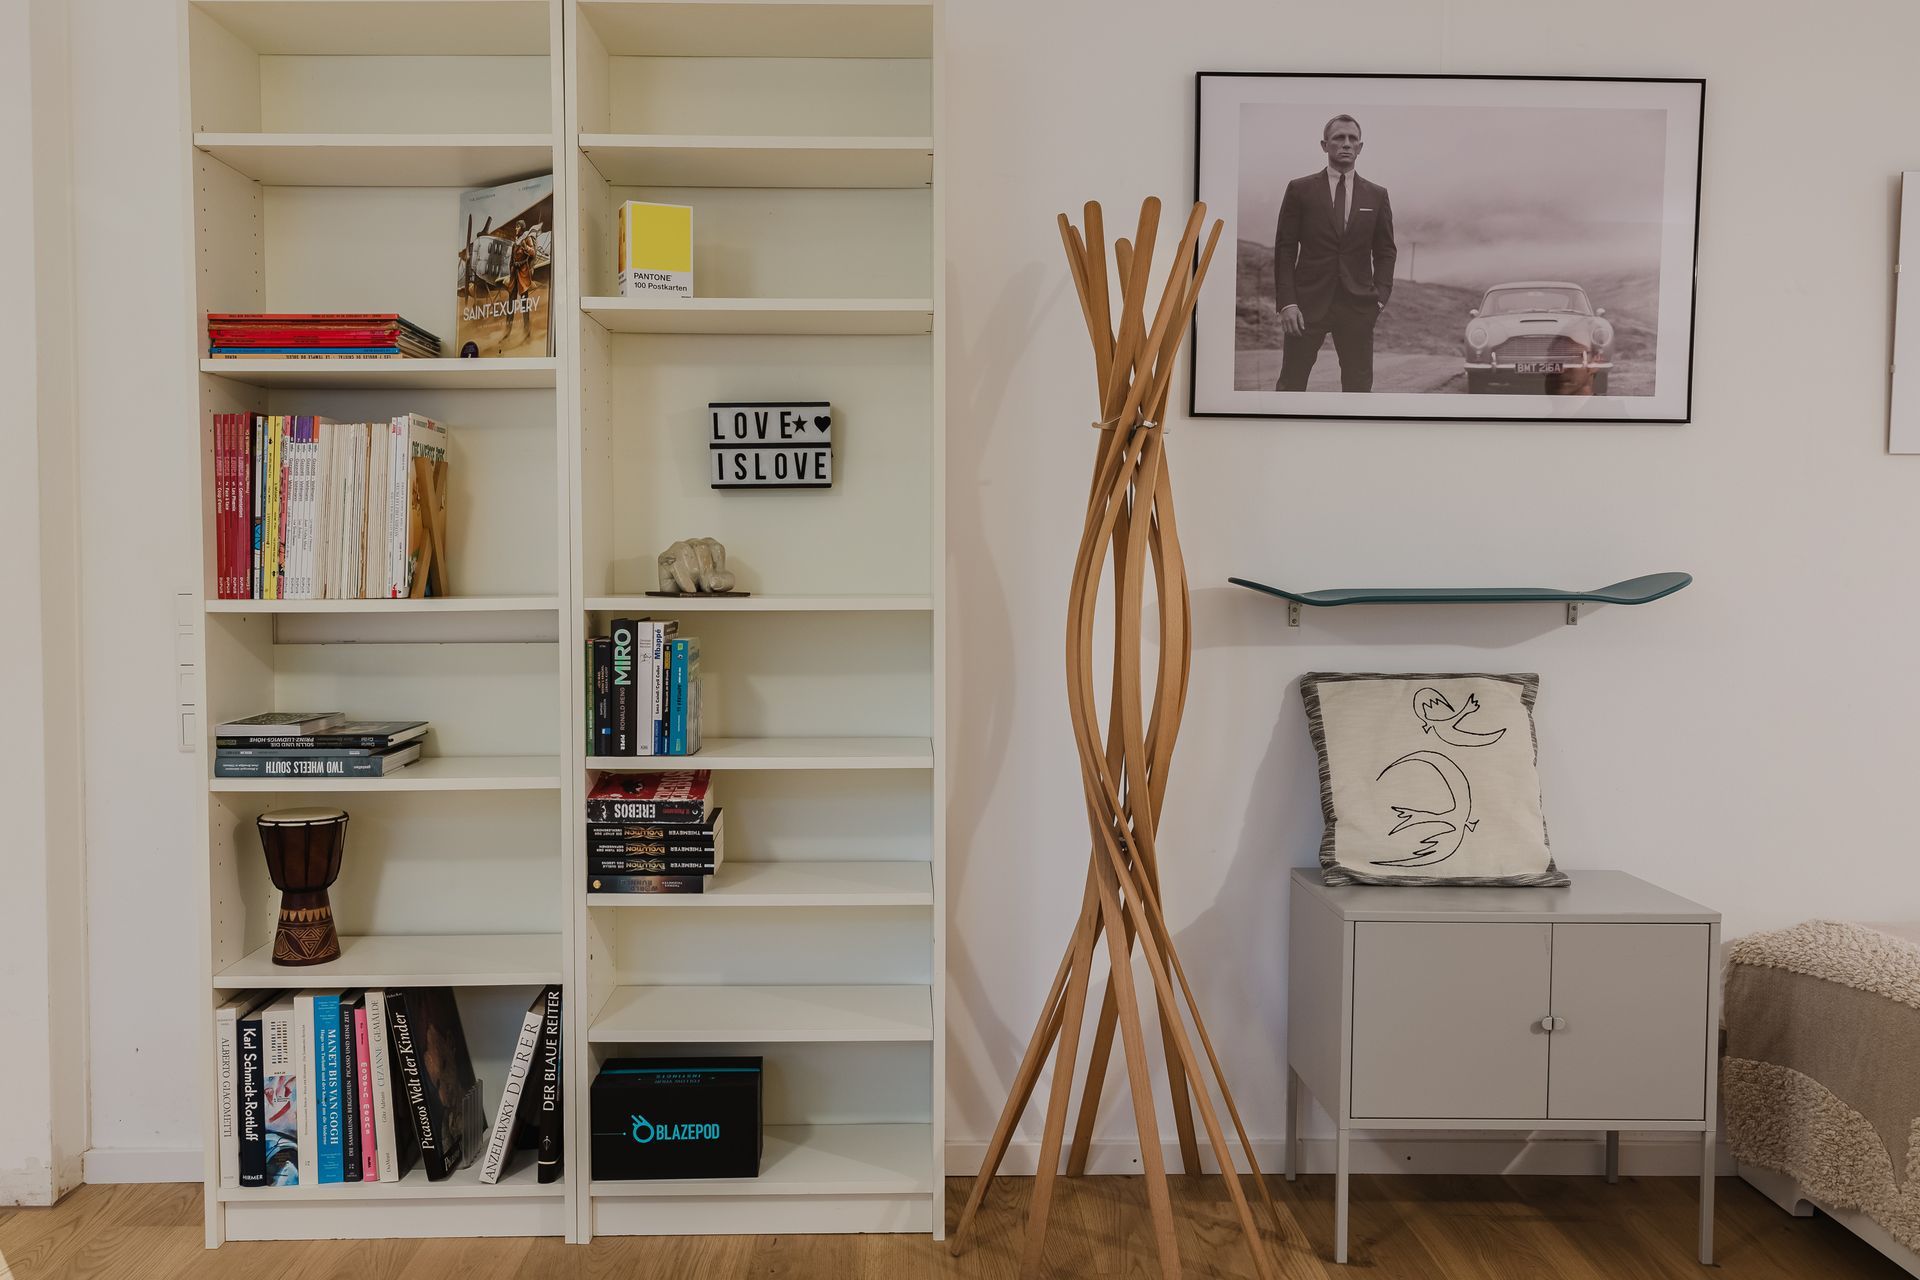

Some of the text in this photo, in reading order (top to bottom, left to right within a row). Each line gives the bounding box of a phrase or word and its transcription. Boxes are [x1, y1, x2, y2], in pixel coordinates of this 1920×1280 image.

[634, 272, 671, 281] PANTONE
[648, 283, 687, 291] Postkarten
[463, 296, 540, 321] SAINT-EXUPÉRY
[1517, 363, 1561, 372] BMT 216A
[713, 412, 792, 439] LOVE
[654, 629, 662, 659] Mbappé
[614, 629, 632, 685] MIRO
[266, 761, 291, 774] SOUTH
[293, 761, 324, 773] WHEELS
[326, 761, 343, 773] TWO
[614, 803, 656, 818] EREBOS
[626, 862, 666, 870] EVOLUTION
[370, 1000, 382, 1042] GEMÄLDE
[327, 1029, 337, 1067] MANET
[542, 991, 560, 1112] DER BLAUE REITER
[221, 1038, 232, 1137] ALBERTO GIACOMETTI
[243, 1028, 257, 1141] Karl Schmidt-Rottluff
[329, 1071, 337, 1088] BIS
[394, 1012, 435, 1150] Picassos Welt der Kinder
[329, 1089, 338, 1110] VAN
[484, 1022, 539, 1180] ANZELEWSKY DÜRER
[330, 1112, 339, 1145] GOGH
[656, 1124, 720, 1140] BLAZEPOD
